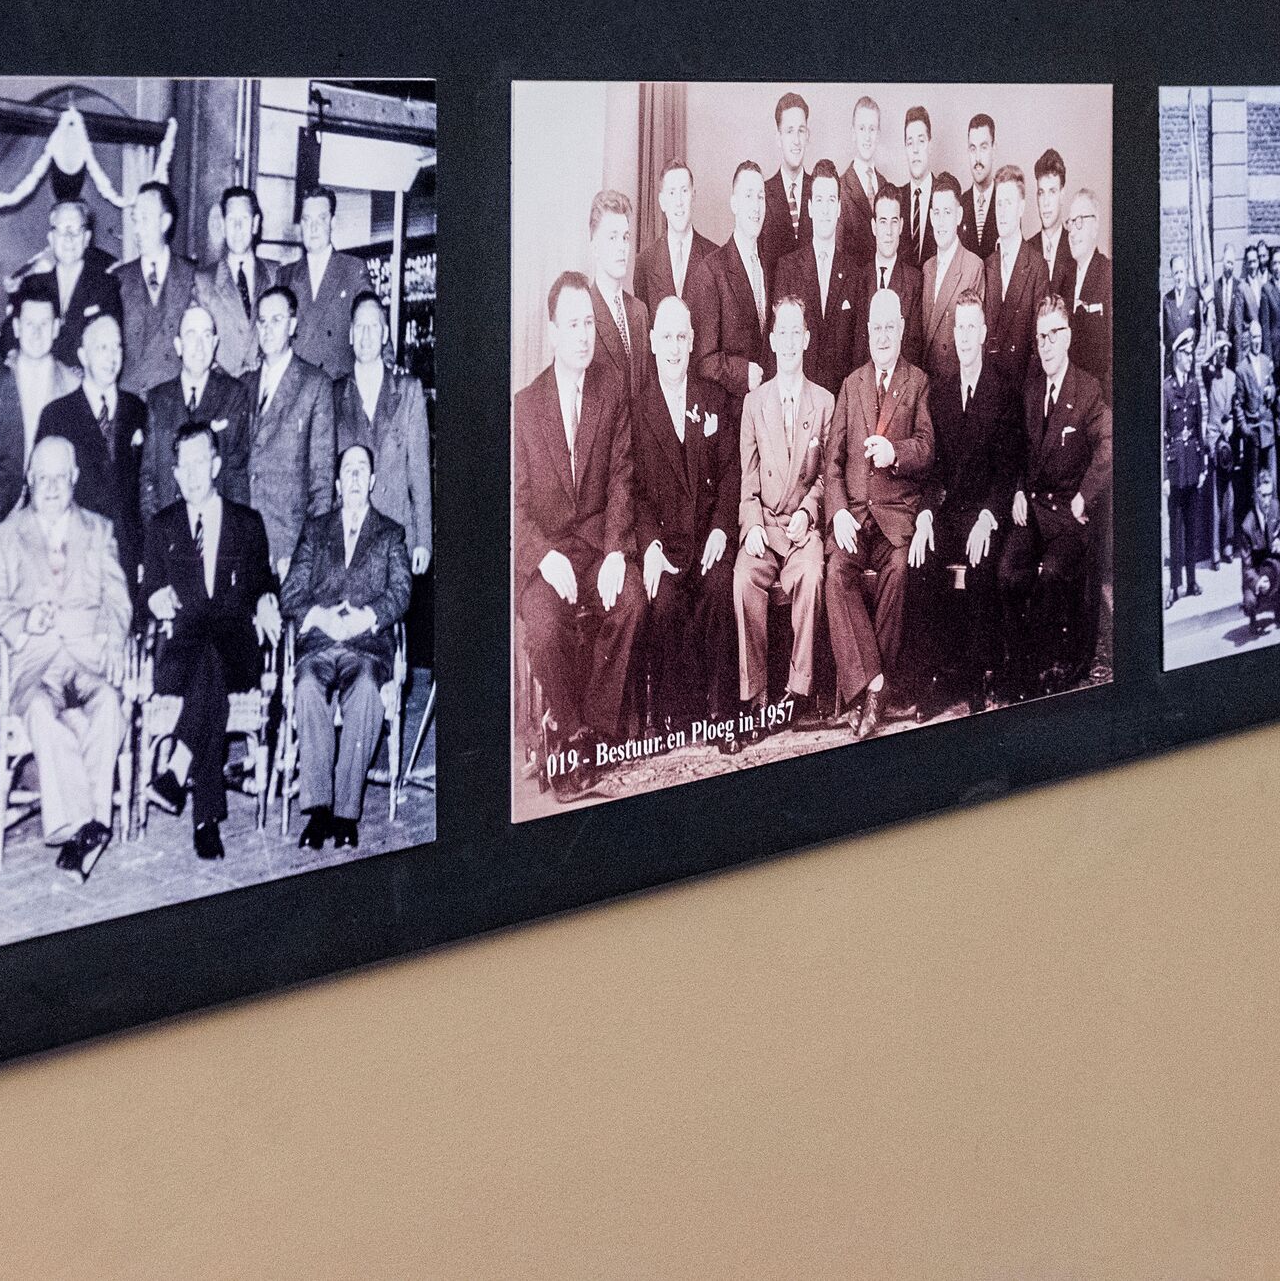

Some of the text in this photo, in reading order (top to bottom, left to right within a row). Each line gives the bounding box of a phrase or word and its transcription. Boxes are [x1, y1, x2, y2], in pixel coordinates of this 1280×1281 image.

[547, 749, 578, 778] 019
[595, 736, 662, 767] Bestuur
[666, 730, 686, 748] en
[691, 718, 735, 745] Ploeg
[738, 711, 754, 733] in
[760, 700, 795, 729] 1957
